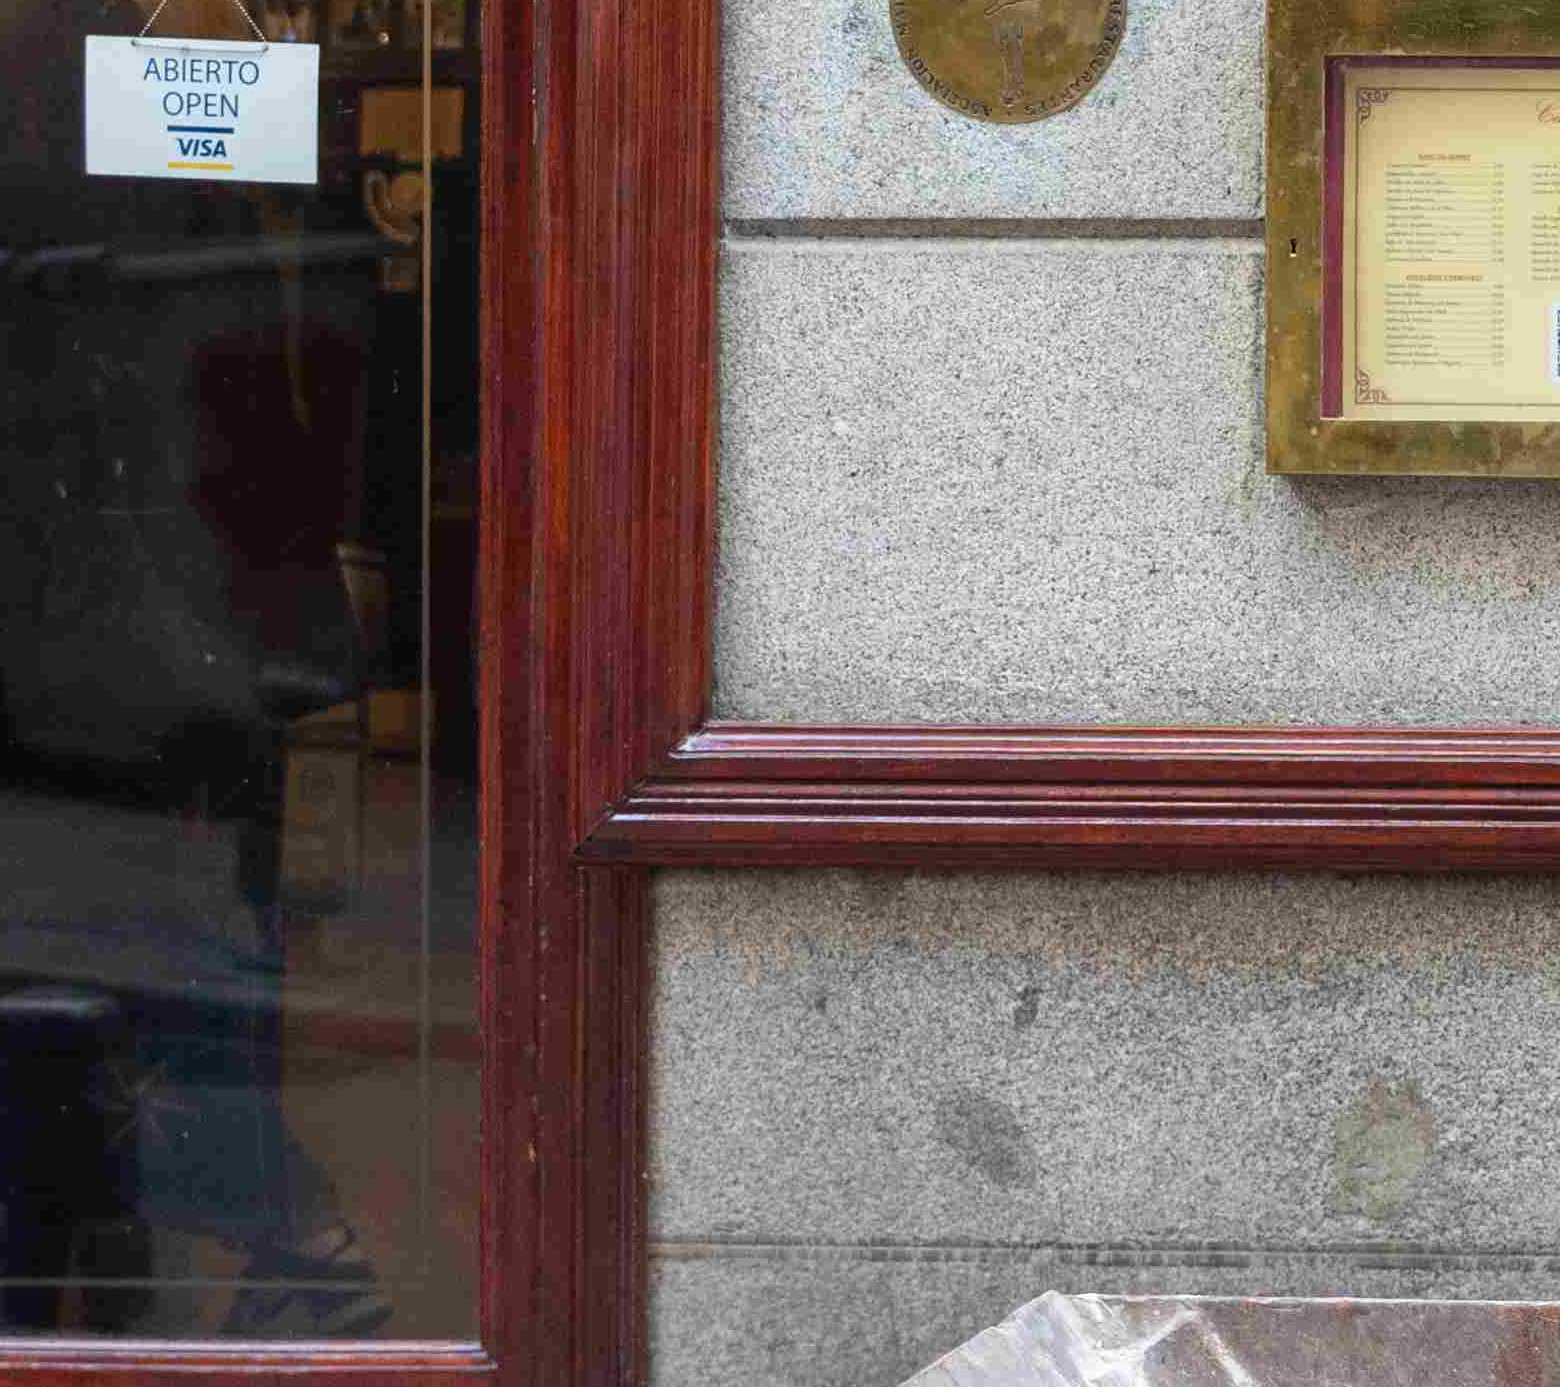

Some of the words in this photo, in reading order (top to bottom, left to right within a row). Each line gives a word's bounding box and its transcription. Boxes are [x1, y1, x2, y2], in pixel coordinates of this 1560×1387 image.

[143, 57, 260, 85] ABIERTO
[162, 92, 239, 118] OPEN
[176, 138, 227, 158] VISA
